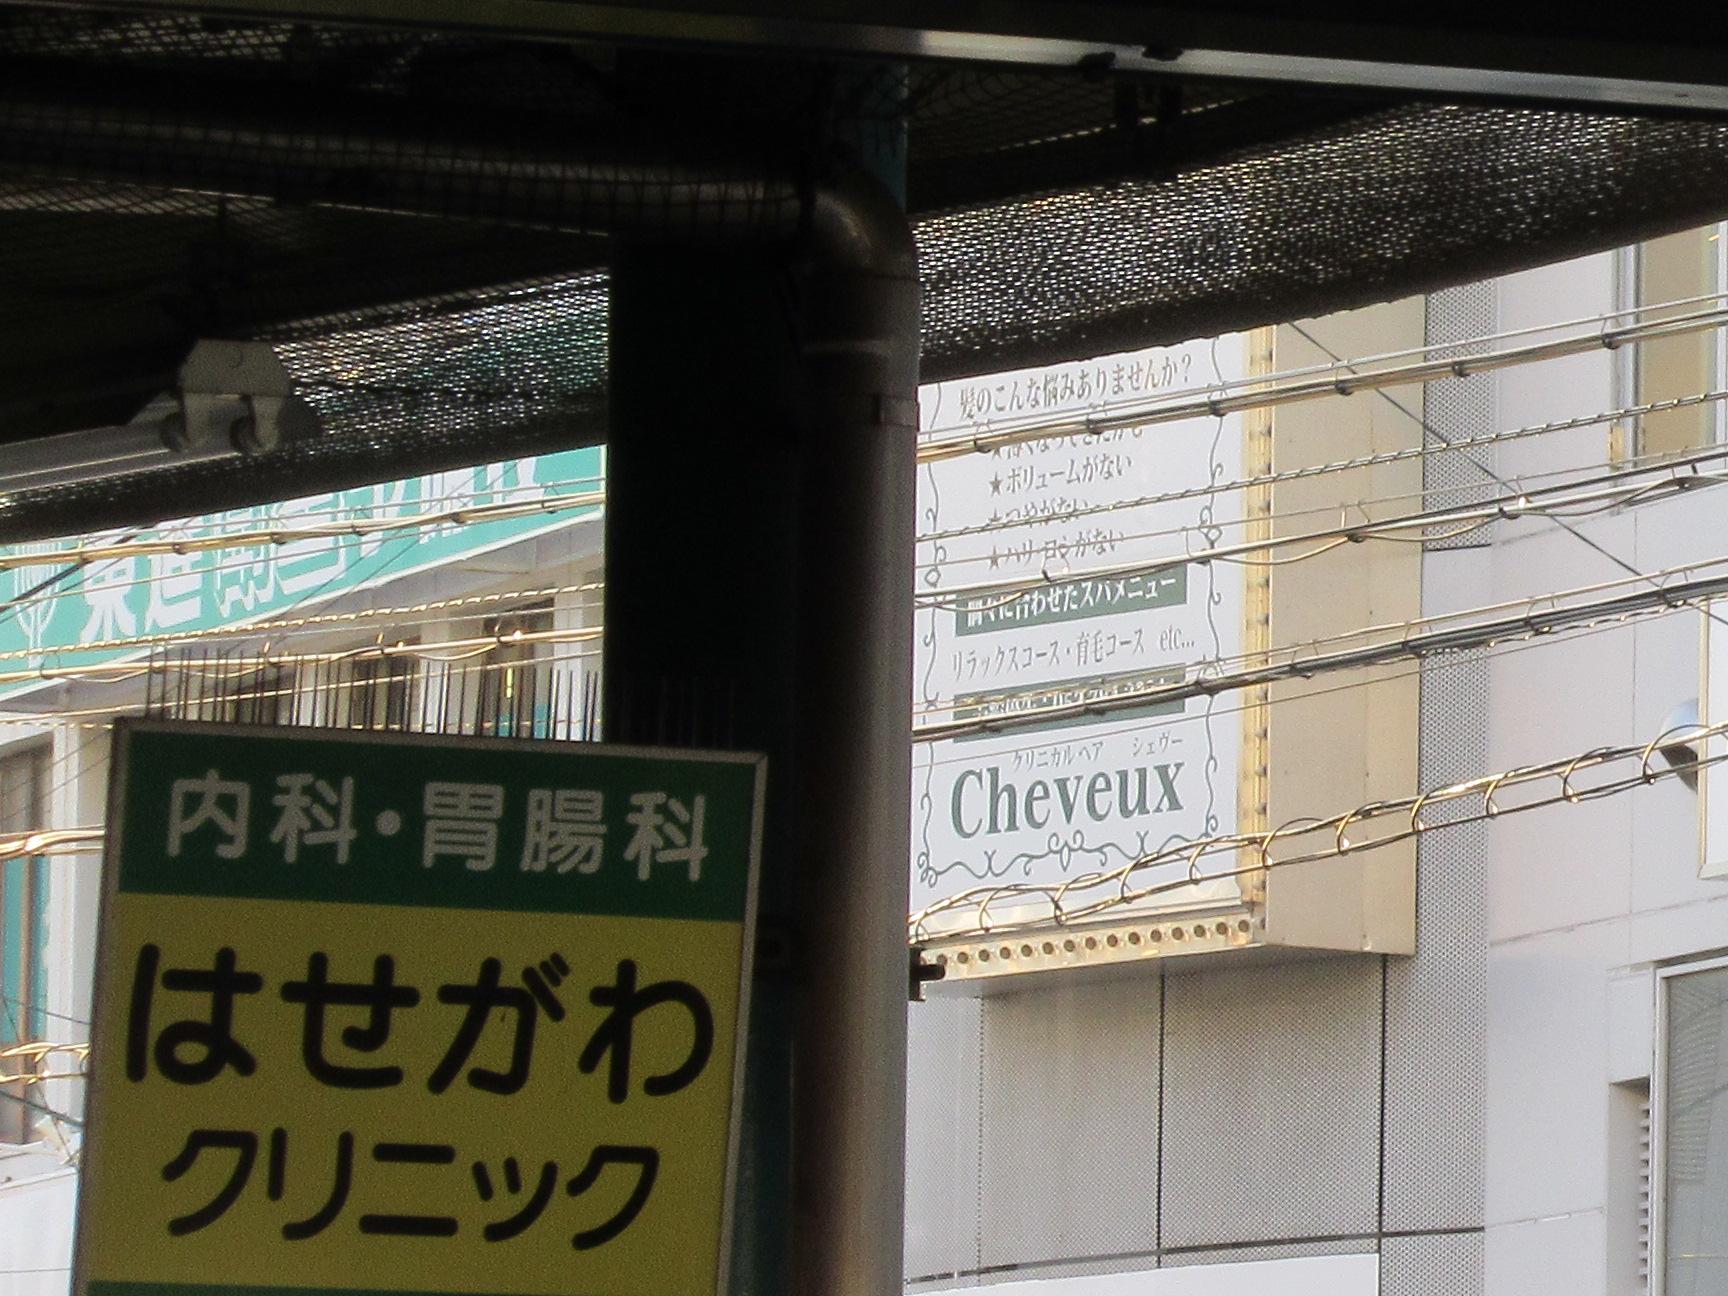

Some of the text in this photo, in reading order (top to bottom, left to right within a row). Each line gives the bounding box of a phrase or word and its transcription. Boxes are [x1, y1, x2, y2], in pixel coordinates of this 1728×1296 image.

[1007, 453, 1132, 494] ボリュームがない
[950, 759, 1185, 840] Cheveux
[1012, 733, 1183, 773] クリニカルヘア シェヴー
[168, 770, 709, 882] 内科・胃腸科
[125, 943, 716, 1104] はせがわ
[162, 1127, 660, 1251] クリニック
